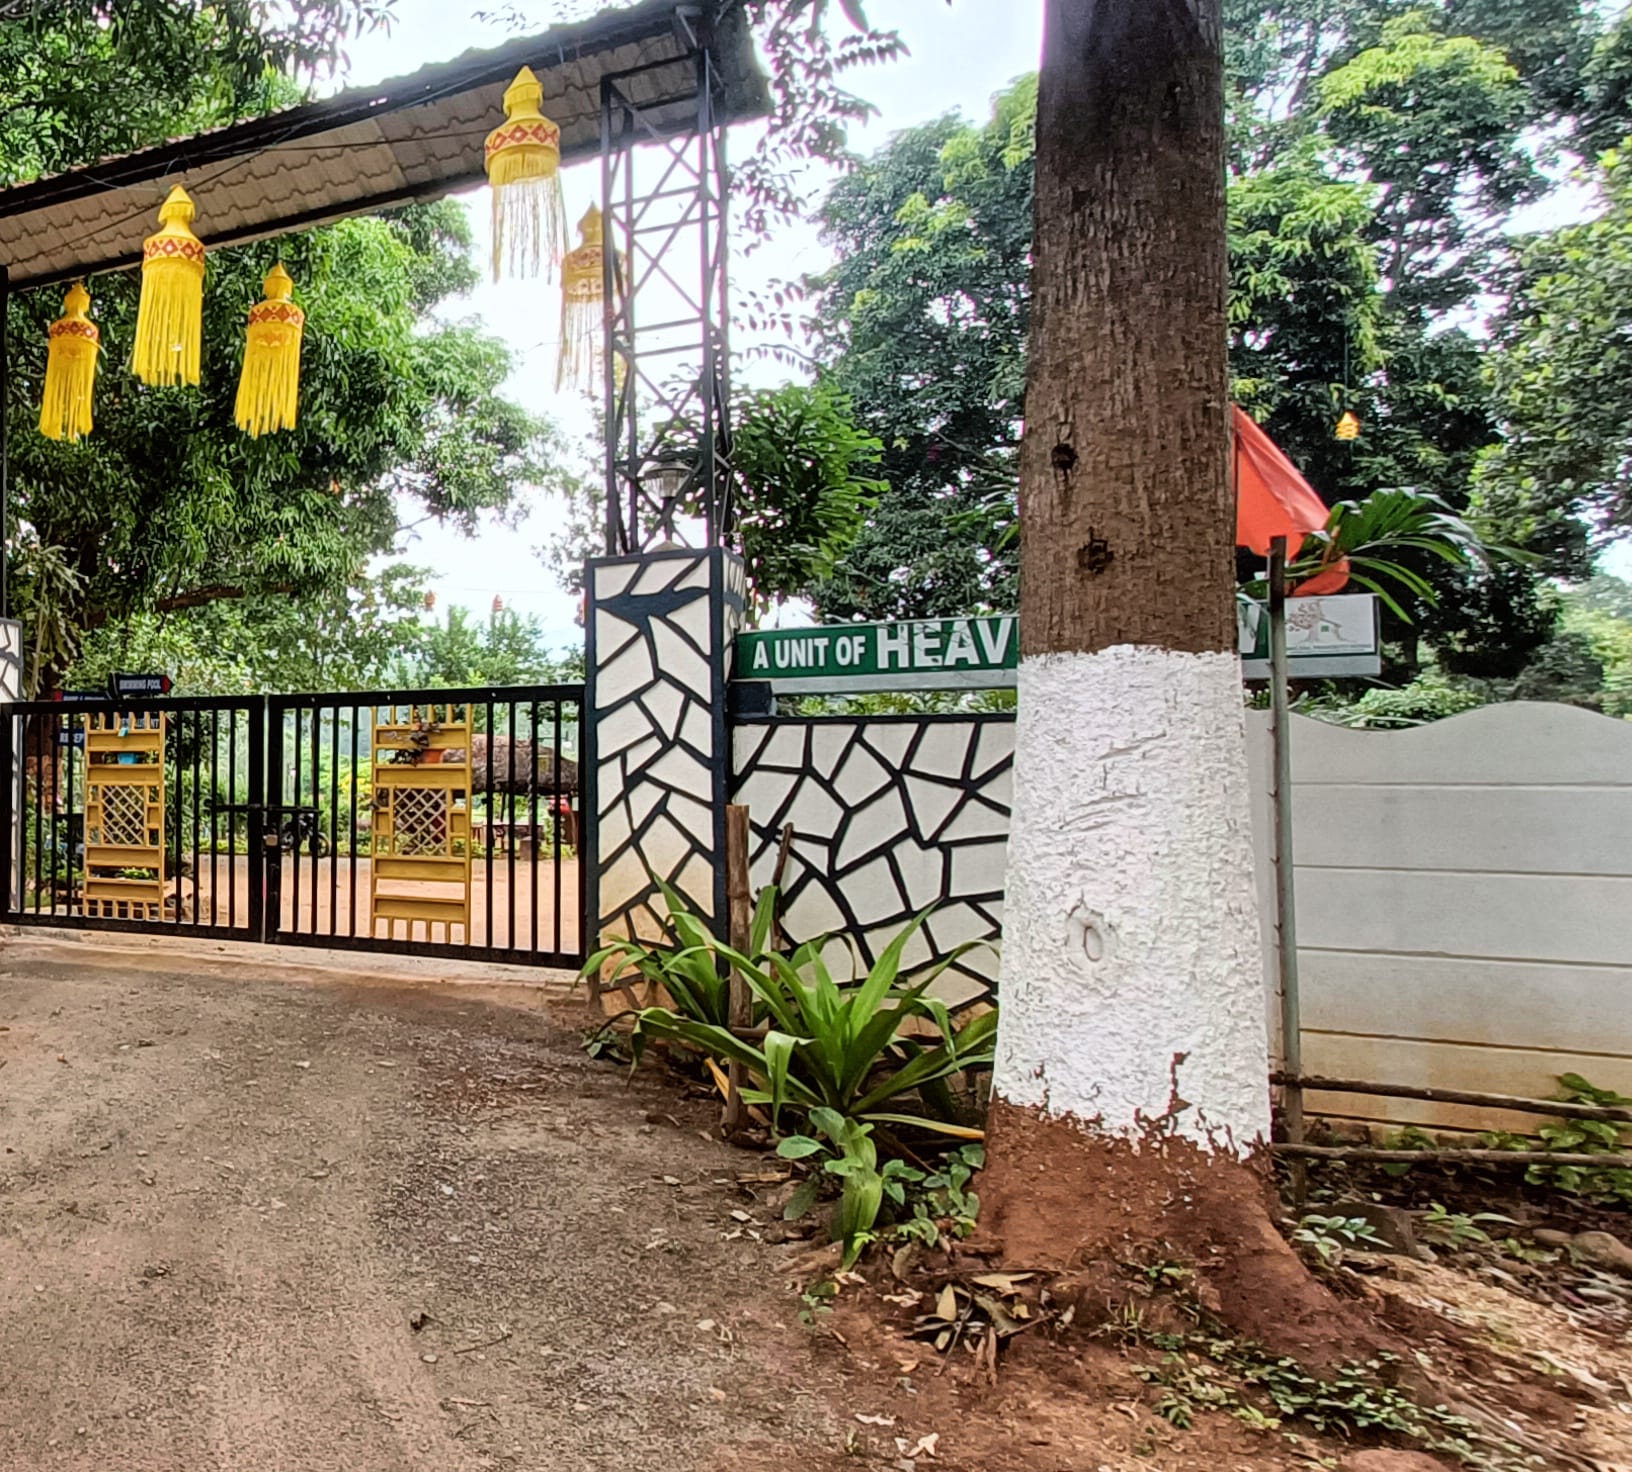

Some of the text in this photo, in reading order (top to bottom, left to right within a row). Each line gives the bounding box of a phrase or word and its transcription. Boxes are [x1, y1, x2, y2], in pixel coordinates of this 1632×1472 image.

[753, 618, 1018, 670] A UNIT OF HEAV
